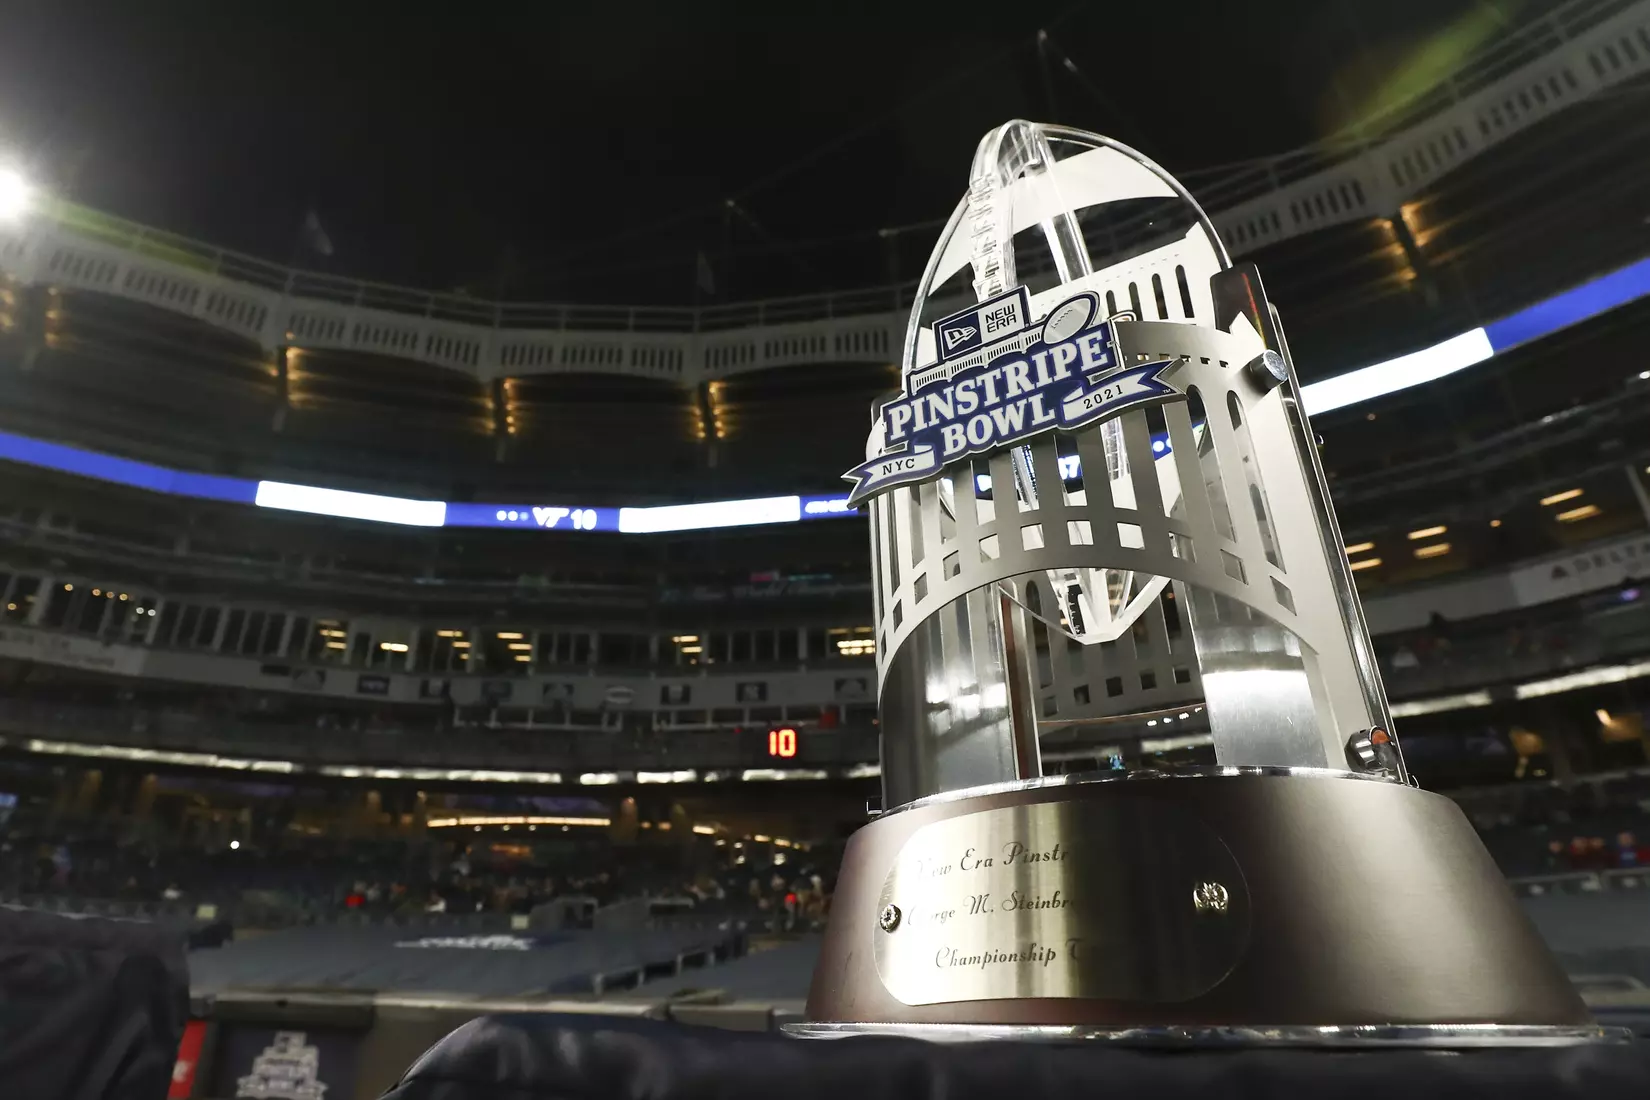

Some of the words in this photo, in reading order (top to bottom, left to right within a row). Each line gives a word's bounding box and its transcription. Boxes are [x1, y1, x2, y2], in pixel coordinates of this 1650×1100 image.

[985, 304, 1015, 324] NEW
[987, 314, 1017, 333] ERA
[888, 330, 1108, 441] PINSTRIPE
[1083, 385, 1124, 410] 2021
[940, 393, 1055, 457] BOWL
[883, 458, 915, 476] NYC
[532, 507, 570, 528] VT
[770, 729, 796, 757] 10
[961, 848, 993, 871] Era
[963, 893, 994, 915] M.
[936, 942, 1057, 969] Championship
